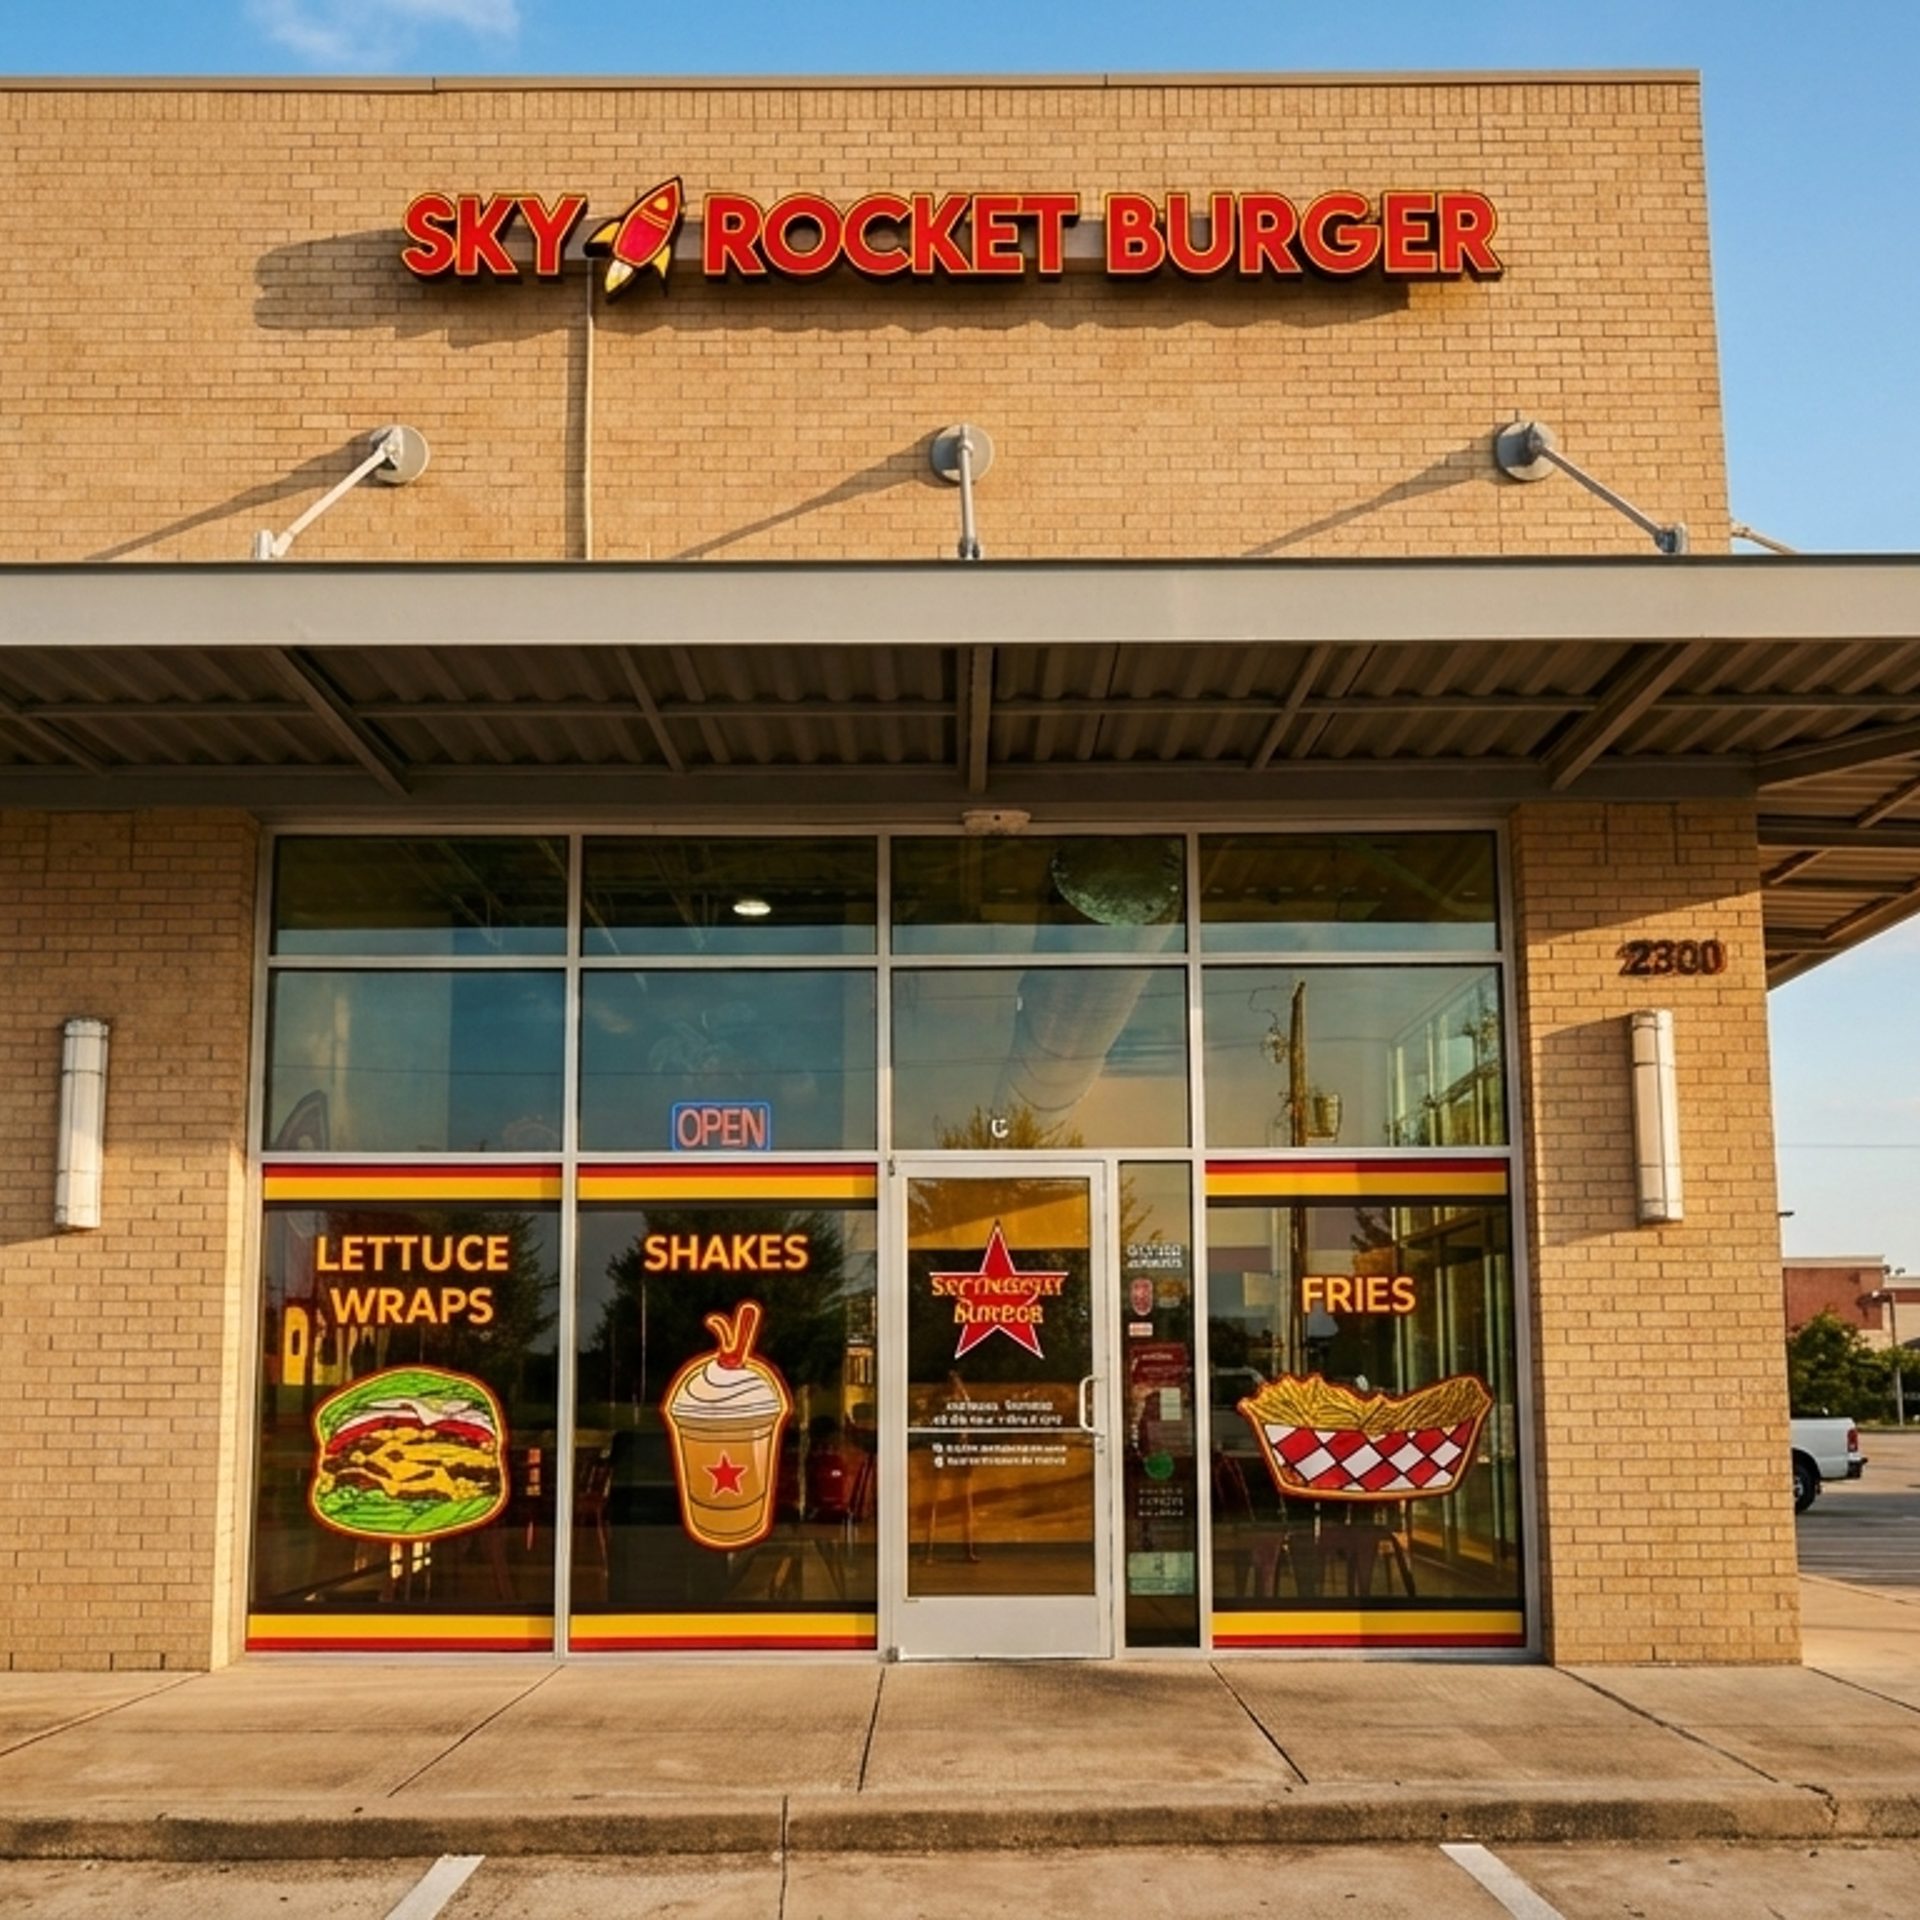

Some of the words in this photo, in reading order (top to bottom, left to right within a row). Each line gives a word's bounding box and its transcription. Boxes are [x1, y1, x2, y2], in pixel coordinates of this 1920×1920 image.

[402, 193, 586, 279] SKY
[700, 191, 1082, 278] ROCKET
[1105, 190, 1502, 277] BURGER
[1620, 940, 1725, 975] 2300
[674, 1107, 768, 1148] OPEN
[316, 1234, 509, 1274] LETTUCE
[643, 1233, 810, 1273] SHAKES
[331, 1286, 494, 1327] WRAPS
[1300, 1276, 1417, 1315] FRIES
